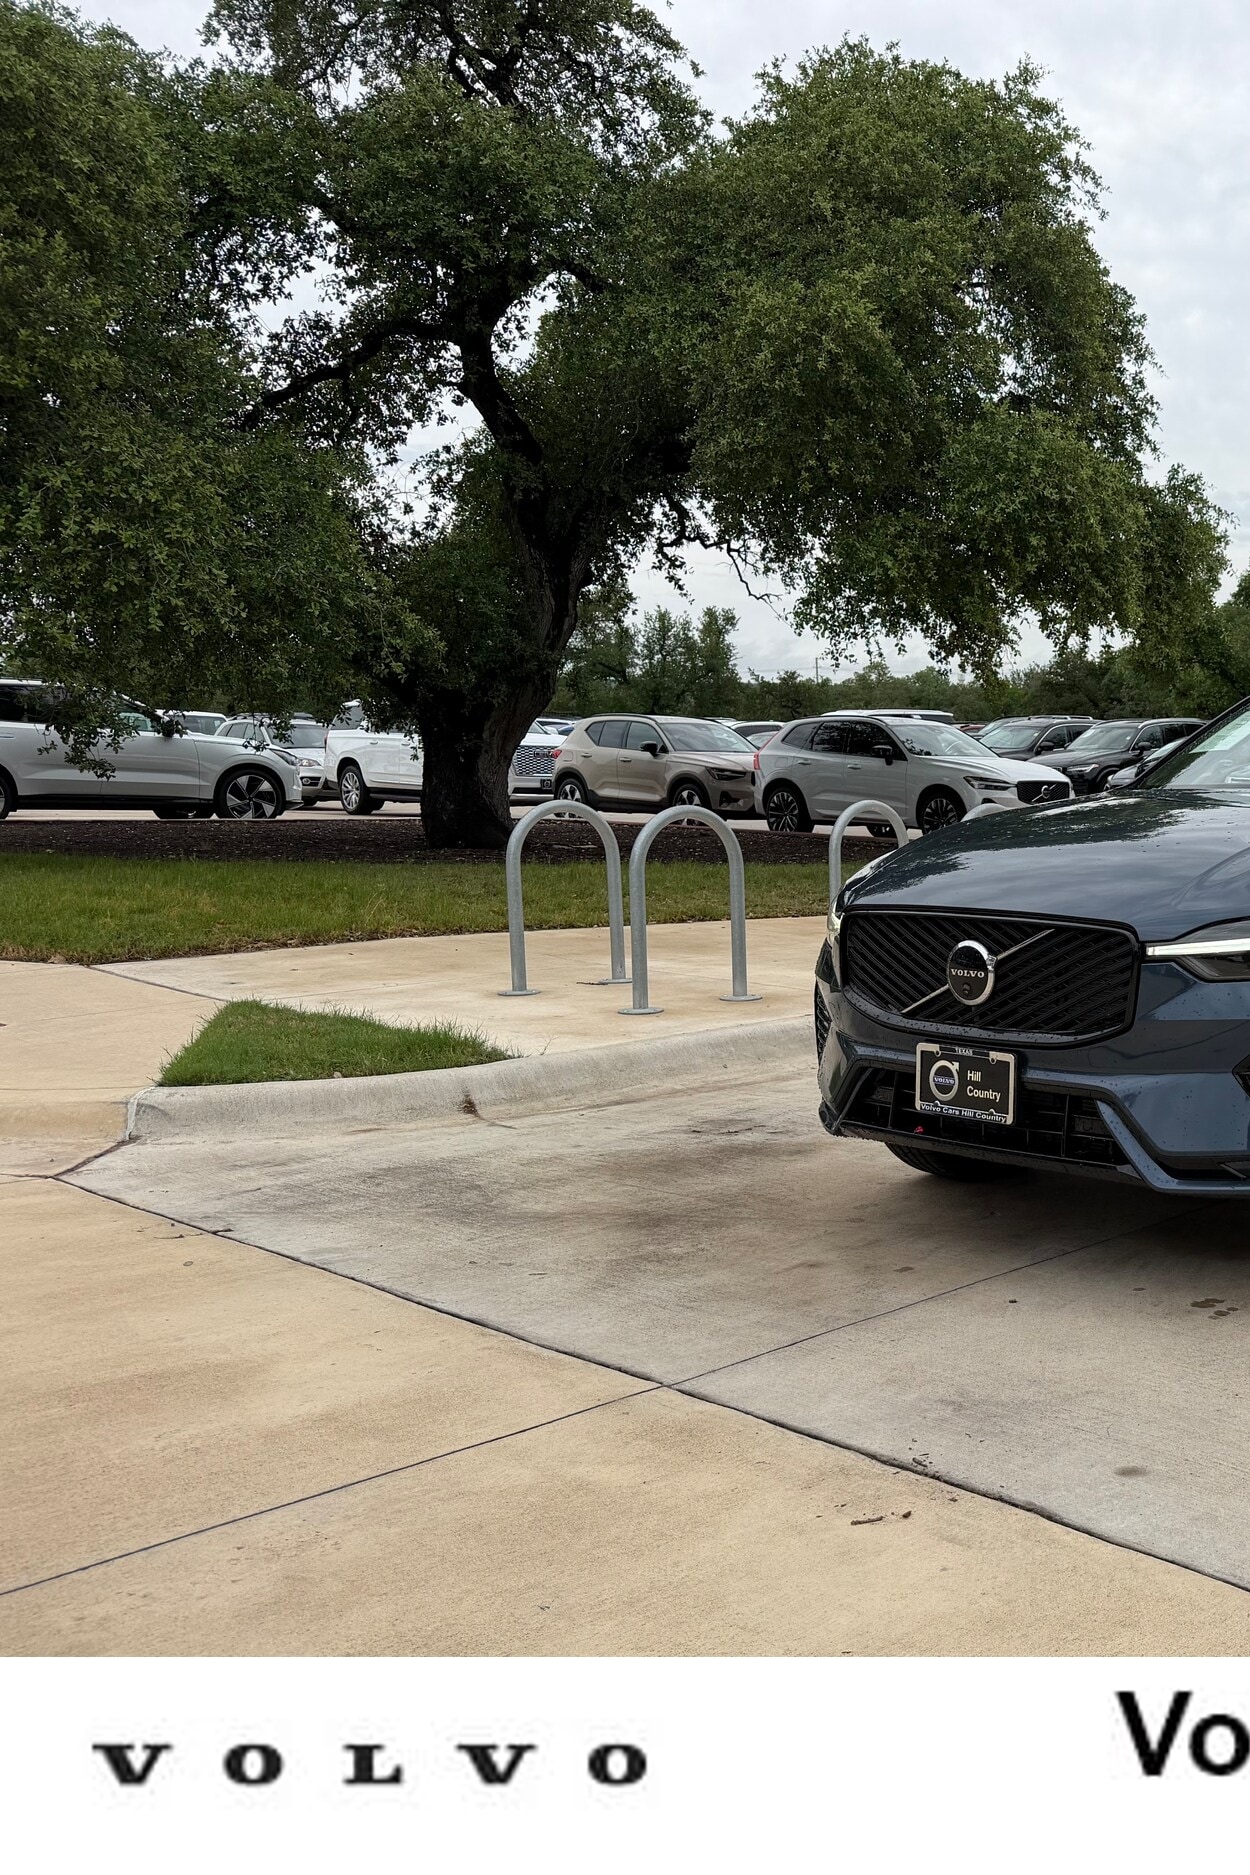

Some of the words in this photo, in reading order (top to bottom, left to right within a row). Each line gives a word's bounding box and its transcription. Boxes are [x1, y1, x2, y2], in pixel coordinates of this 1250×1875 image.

[950, 968, 985, 978] VOLVO
[955, 1047, 973, 1056] TEXAS
[934, 1077, 955, 1085] VOLVO
[967, 1070, 982, 1082] Hill
[966, 1086, 1001, 1102] Country
[921, 1103, 941, 1112] Volvo
[942, 1106, 960, 1115] Cars
[961, 1109, 974, 1117] Hill
[975, 1112, 1006, 1123] Country
